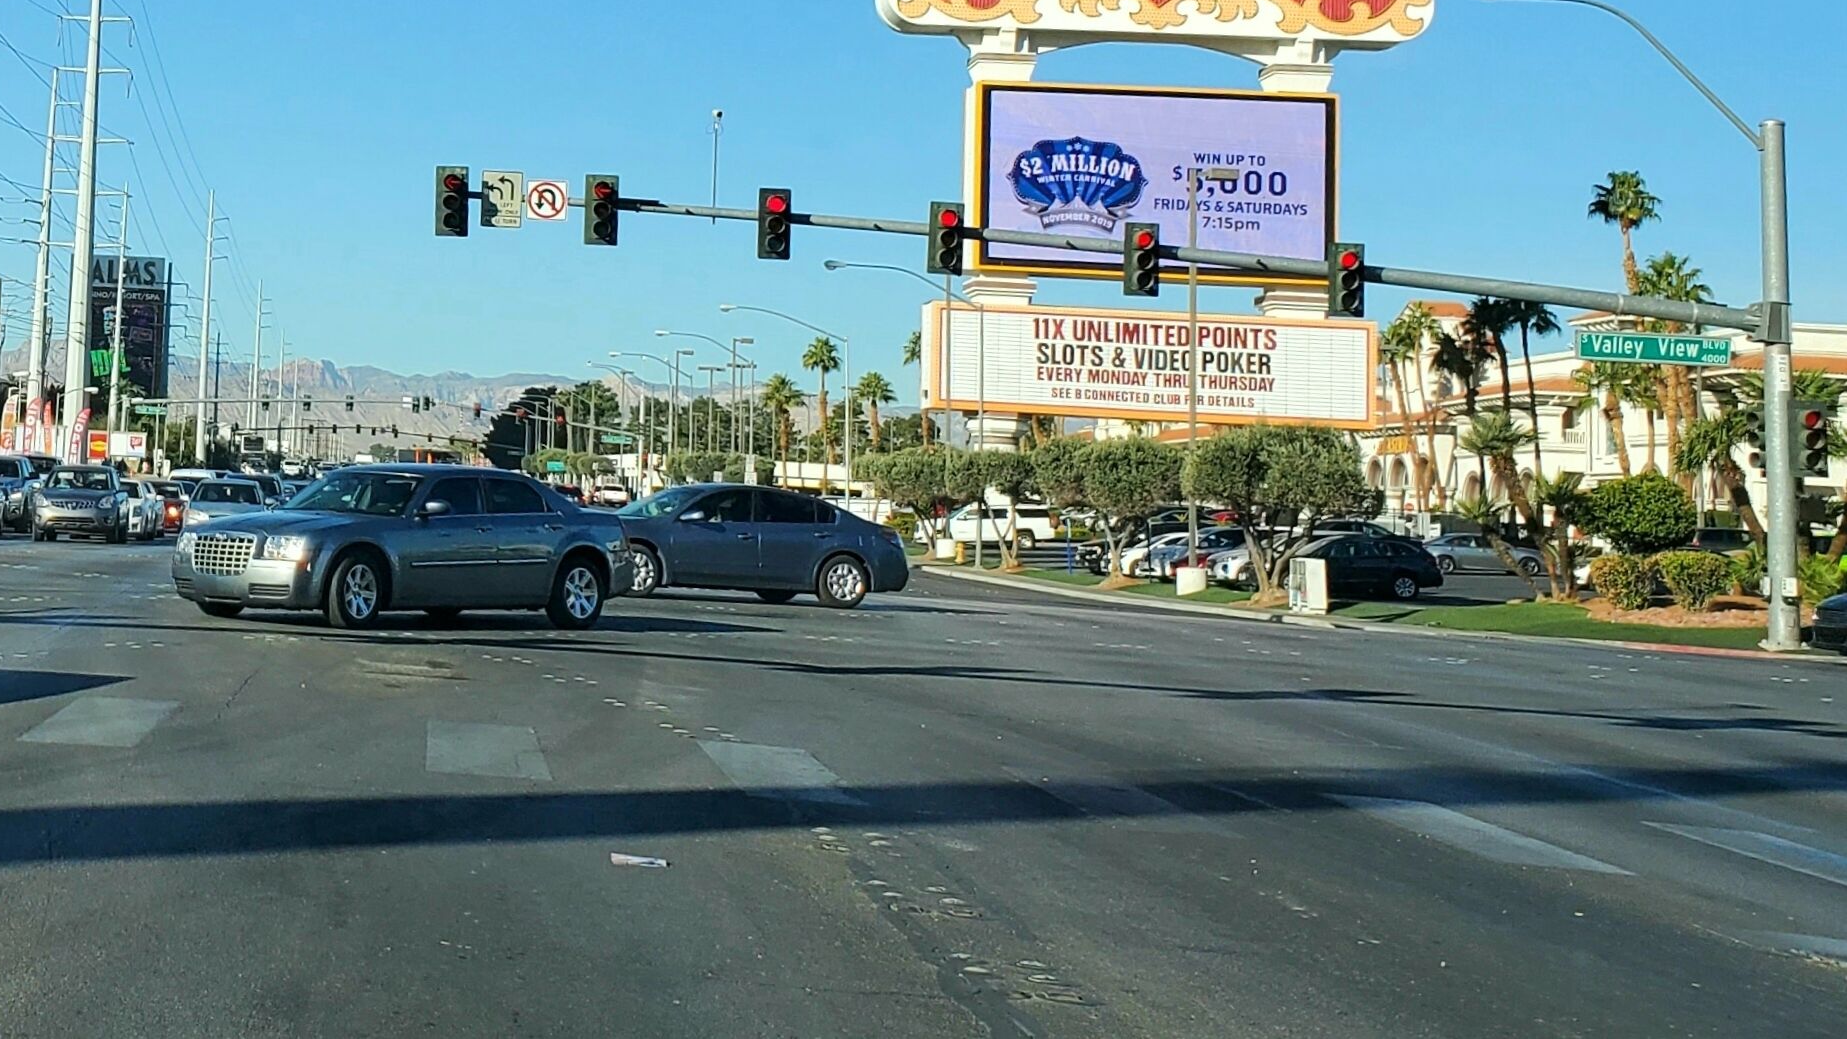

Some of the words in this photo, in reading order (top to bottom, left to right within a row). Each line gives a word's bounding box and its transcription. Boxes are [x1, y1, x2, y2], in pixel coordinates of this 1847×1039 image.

[1019, 157, 1044, 178] $2
[1050, 153, 1136, 181] MILLION
[1193, 152, 1221, 164] WIN
[1226, 154, 1245, 166] UP
[1248, 155, 1267, 167] TO
[1036, 174, 1072, 184] WINTER
[1073, 174, 1116, 188] CARNIVAL
[1214, 200, 1224, 213] &
[1227, 201, 1309, 216] SATURDAYS
[1042, 213, 1091, 226] NOVEMBER
[1092, 215, 1114, 229] 2019
[1202, 216, 1261, 232] 7:15pm
[93, 258, 157, 286] ALMS
[1033, 317, 1066, 341] 11X
[1072, 319, 1191, 347] UNLIMITED
[1197, 326, 1277, 351] POINTS
[1591, 334, 1645, 359] Valley
[1657, 337, 1700, 358] View
[1702, 340, 1727, 350] BLVD
[1036, 342, 1105, 367] SLOTS
[1112, 346, 1127, 369] &
[1202, 351, 1272, 376] POKER
[1702, 353, 1727, 364] 4000
[1036, 366, 1083, 383] EVERY
[1088, 369, 1148, 387] MONDAY
[1197, 374, 1276, 393] THURSDAY
[1051, 387, 1072, 399] SEE
[1153, 393, 1181, 405] CLUB
[1184, 394, 1205, 406] FR
[1207, 395, 1255, 408] DETAILS
